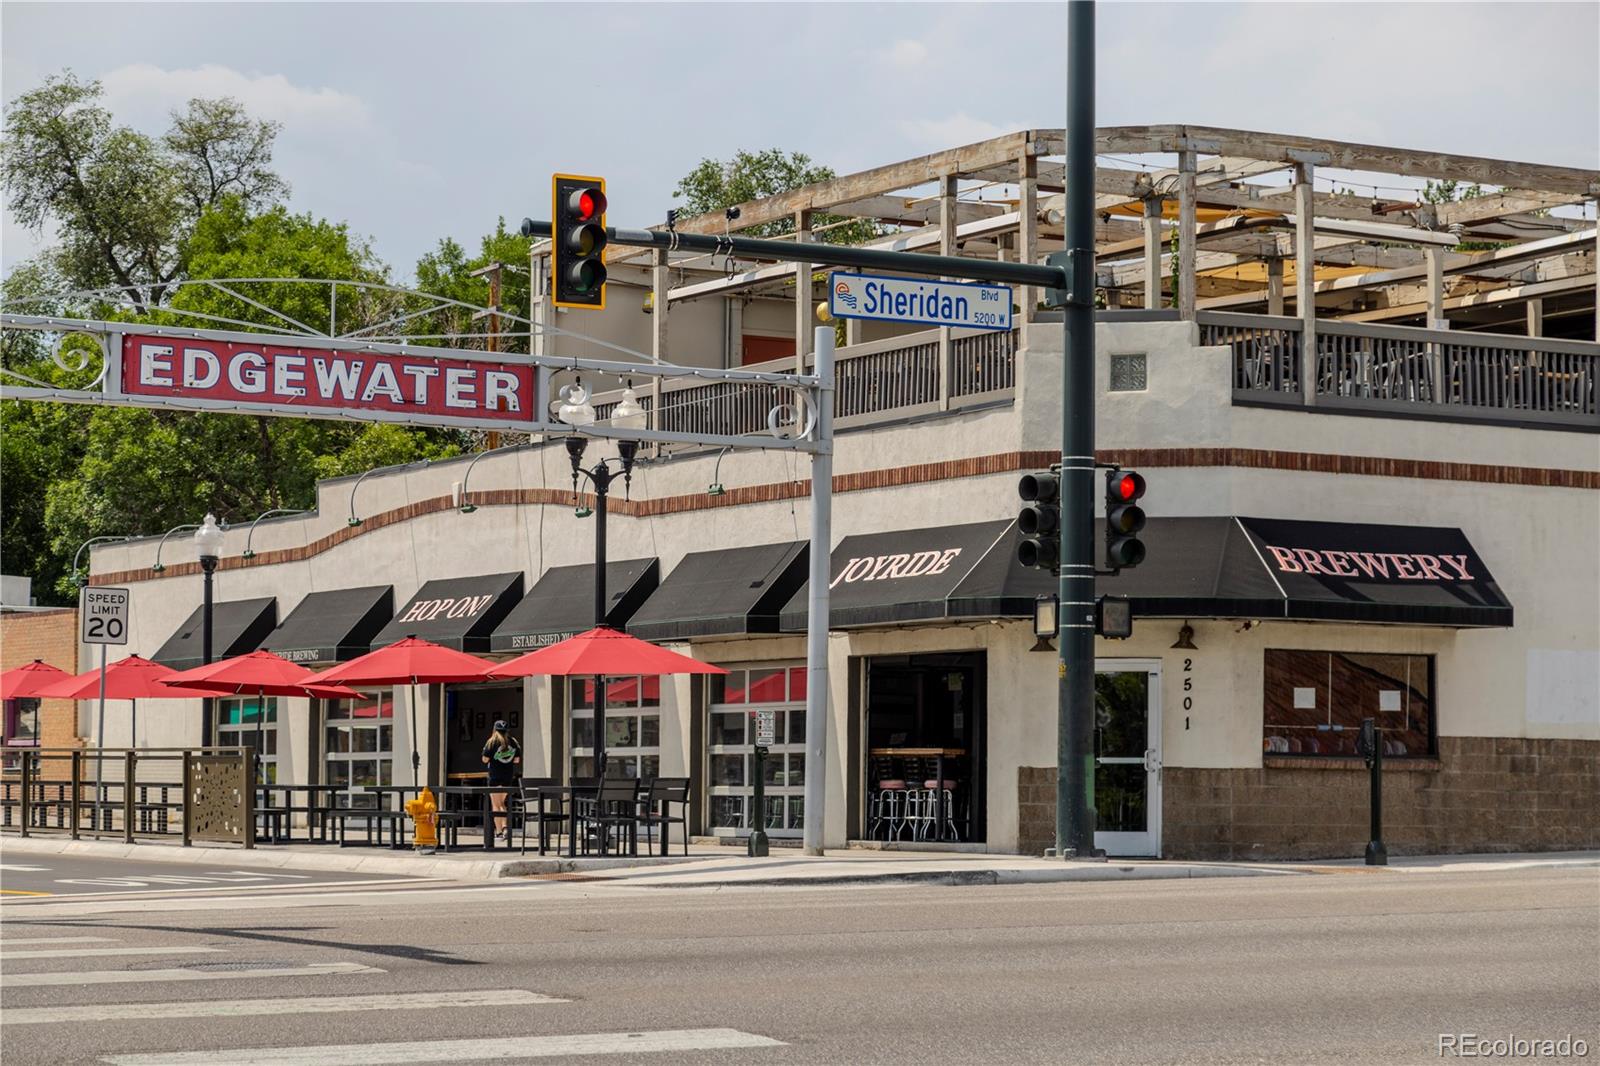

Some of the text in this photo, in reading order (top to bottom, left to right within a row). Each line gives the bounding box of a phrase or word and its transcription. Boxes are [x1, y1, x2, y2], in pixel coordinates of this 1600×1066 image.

[864, 282, 999, 320] Sheridan Blvd
[974, 312, 1006, 325] 5200 W
[140, 343, 521, 412] EDGEWATER
[829, 548, 962, 589] JOYRIDE
[1266, 545, 1475, 580] BREWERY
[88, 593, 126, 604] SPEED
[399, 594, 493, 622] HOP ON!
[91, 605, 120, 615] LIMIT
[88, 617, 123, 638] 20
[512, 633, 560, 648] ESTABLISHED
[293, 649, 319, 661] BREWING
[1183, 658, 1193, 731] 2501
[54, 870, 311, 887] ONLY
